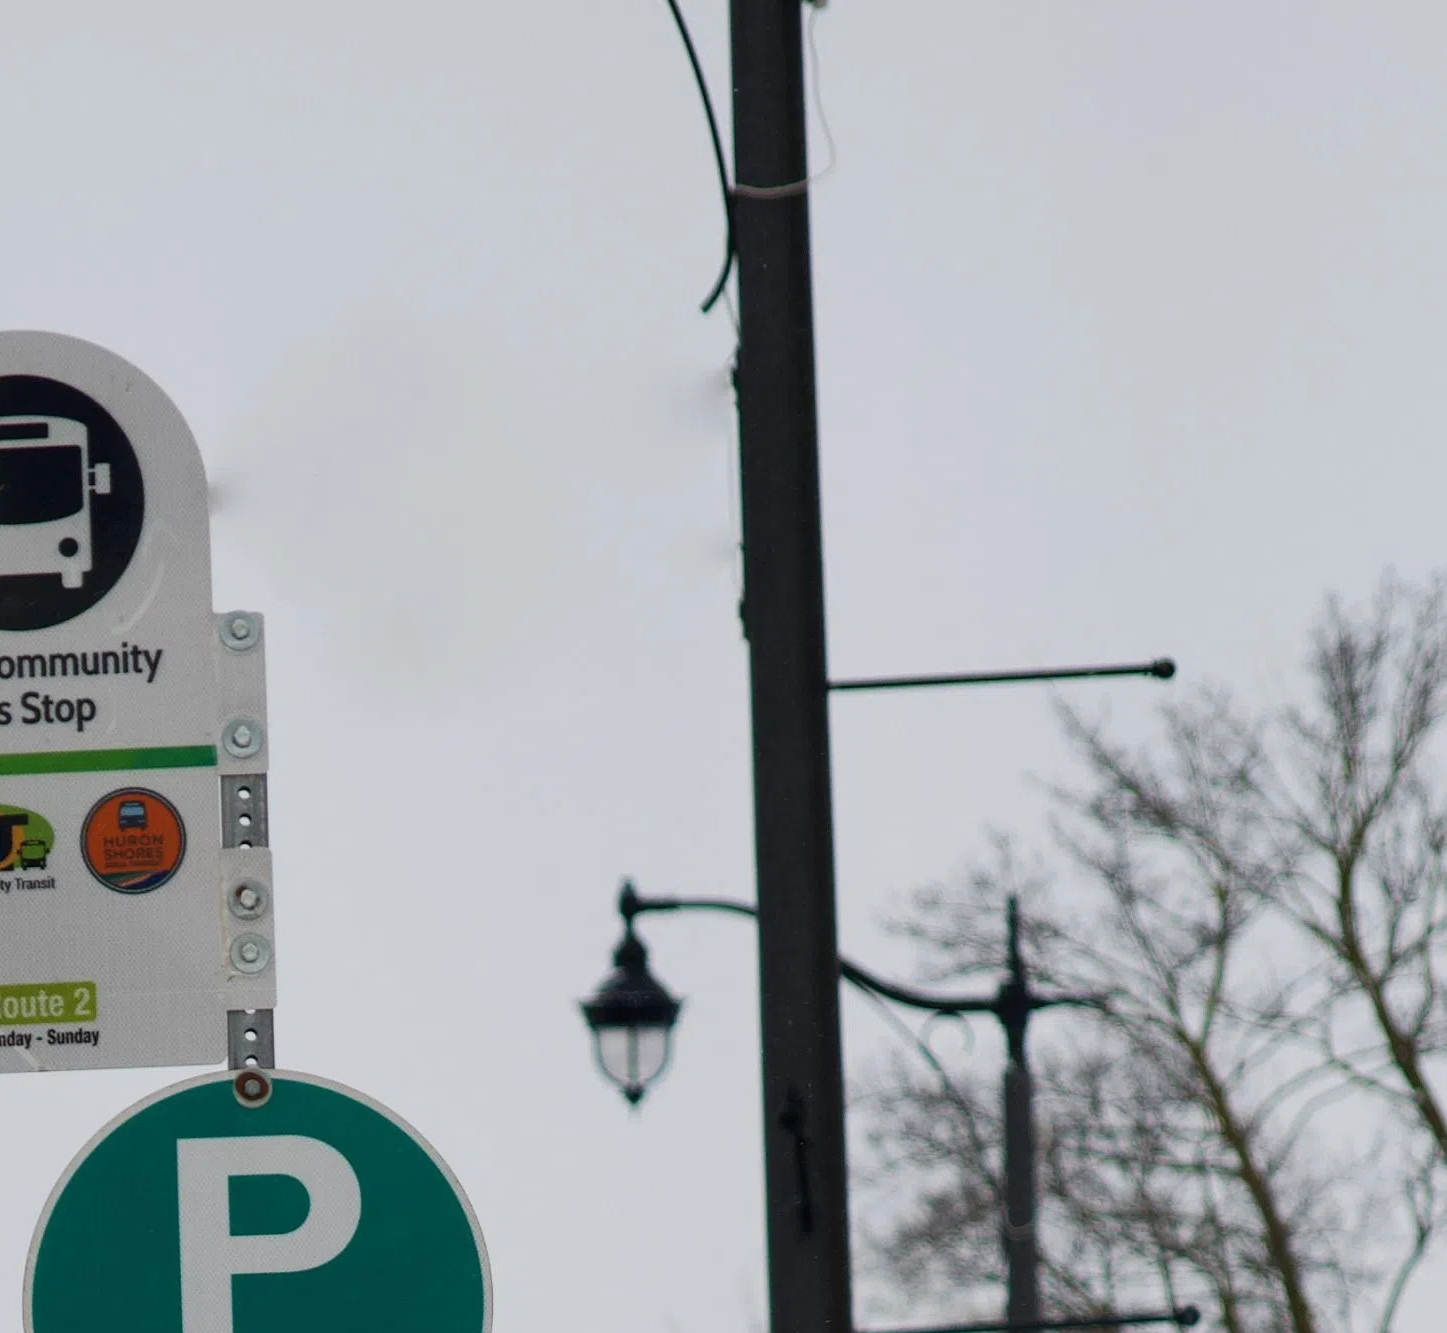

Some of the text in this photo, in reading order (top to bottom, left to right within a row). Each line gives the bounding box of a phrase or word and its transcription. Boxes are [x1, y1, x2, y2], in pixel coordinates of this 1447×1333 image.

[21, 691, 96, 731] Stop
[15, 876, 55, 891] Transit
[74, 987, 91, 1016] 2
[46, 1028, 100, 1047] Sunday
